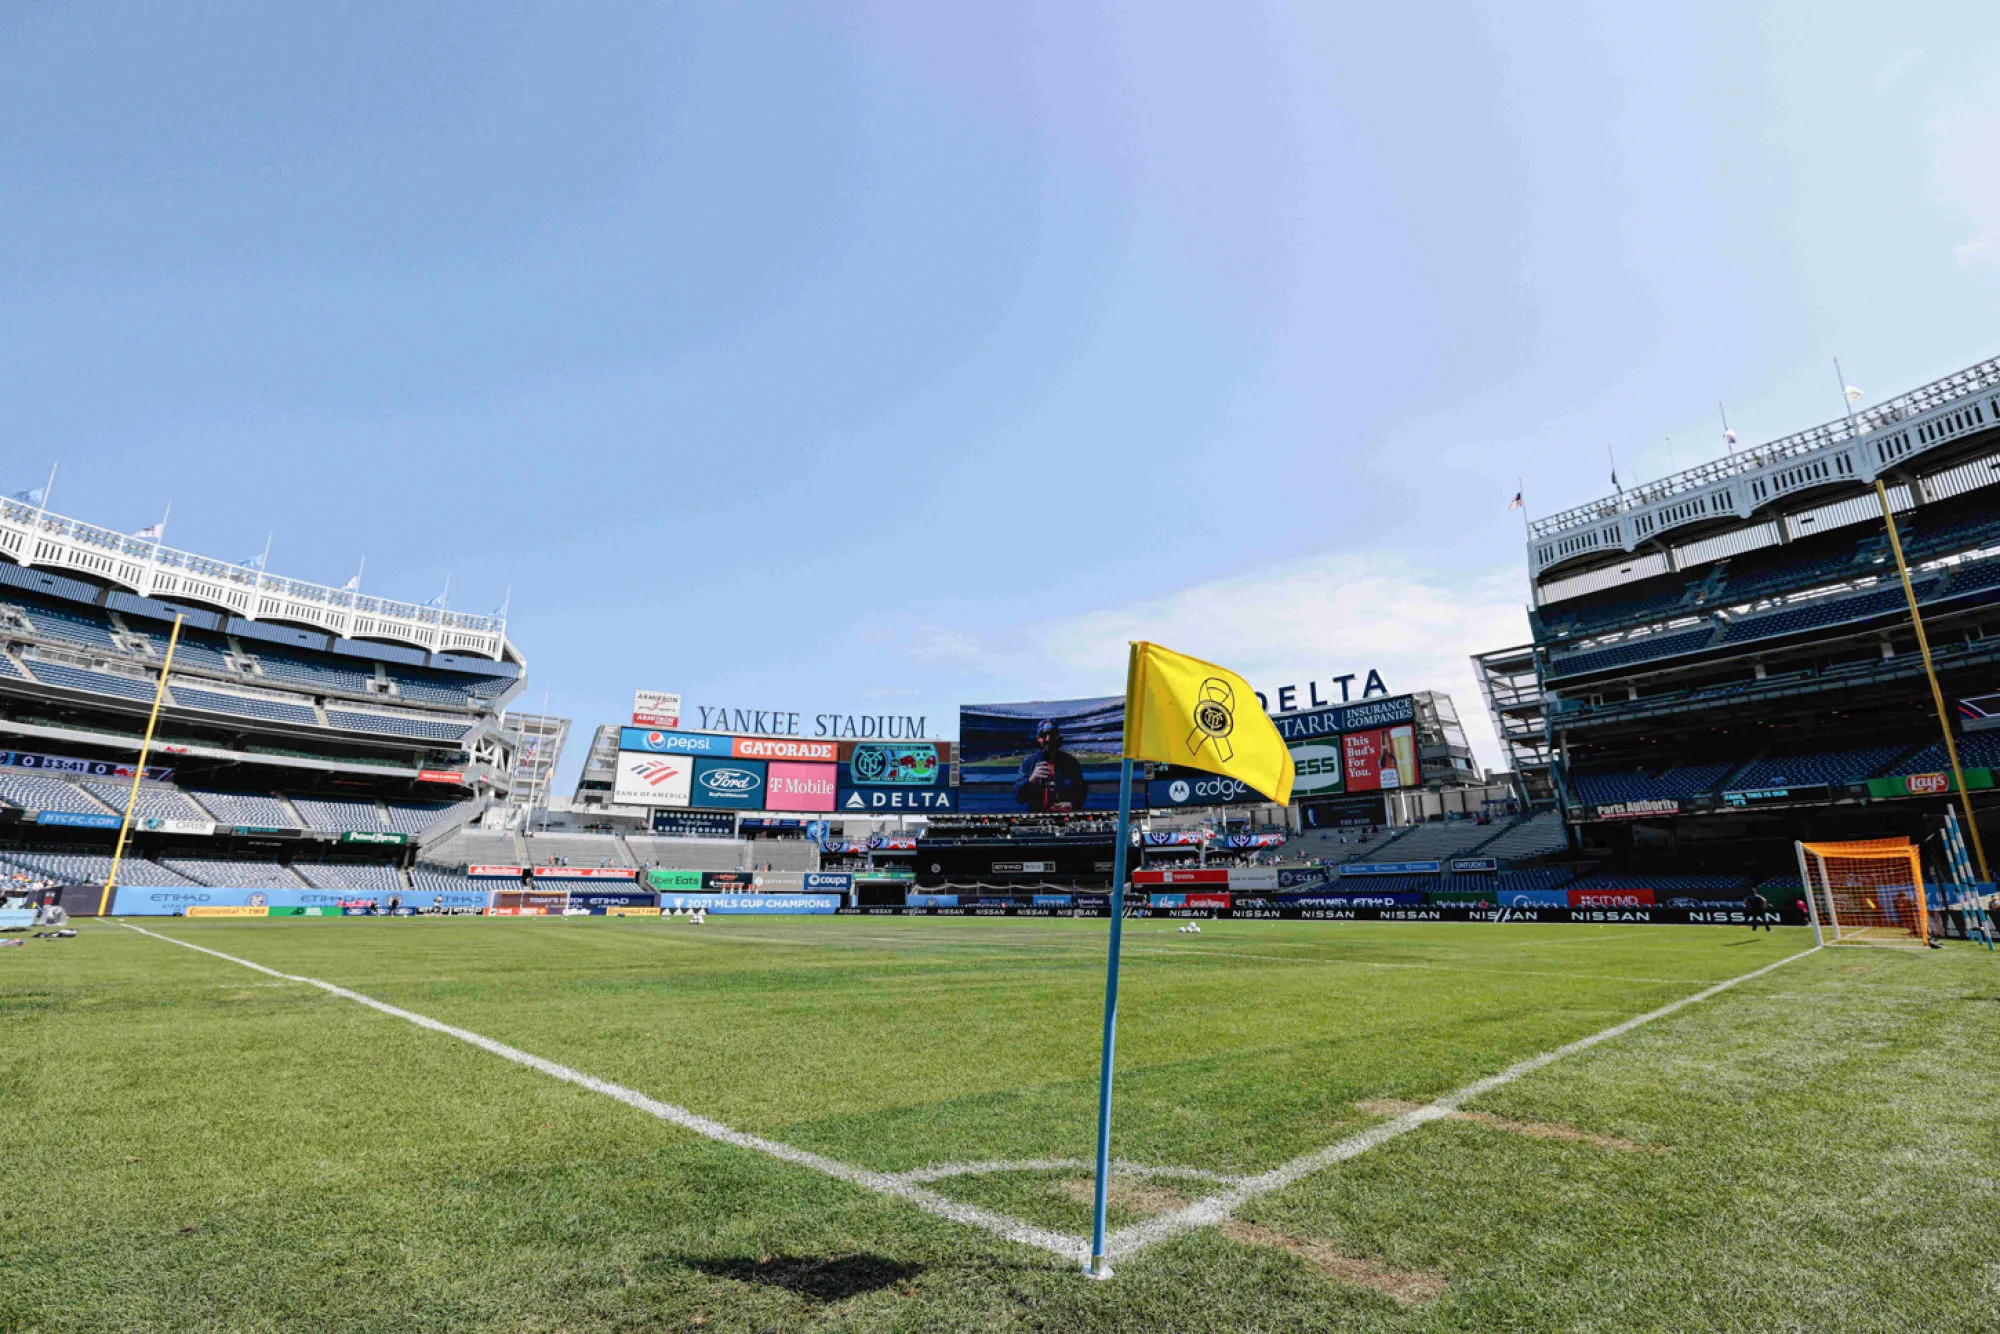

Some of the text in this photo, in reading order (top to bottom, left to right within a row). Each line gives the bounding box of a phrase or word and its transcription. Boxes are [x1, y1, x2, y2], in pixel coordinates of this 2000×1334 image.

[1346, 697, 1412, 719] INSURANCE
[697, 705, 927, 739] YANKEE STADIUM
[1347, 709, 1413, 728] COMPANIES
[1275, 713, 1340, 738] TARR
[667, 737, 711, 751] pepsi
[1344, 736, 1370, 747] This
[740, 741, 832, 758] GATORADE
[1347, 745, 1375, 756] Bud's
[22, 756, 107, 775] 0 33:41 0
[1295, 757, 1335, 776] ESS
[1348, 758, 1365, 768] For
[1348, 767, 1372, 777] You.
[710, 771, 749, 789] Ford
[1911, 774, 1946, 792] Lay's
[785, 779, 834, 794] Mobile
[1195, 777, 1247, 800] edge
[872, 792, 950, 807] DELTA
[1597, 803, 1626, 816] Parts
[1626, 799, 1680, 814] Authority
[45, 814, 116, 826] NYCFC.COM
[650, 875, 699, 885] Uber Eats
[820, 875, 847, 886] coupa
[151, 893, 211, 902] ETIHAD
[686, 900, 832, 909] 2021 MLS CUP CHAMPIONS
[189, 906, 240, 917] Continental
[975, 908, 1006, 916] NISSAN
[1017, 908, 1049, 916] NISSAN
[1301, 910, 1355, 918] NISSAN
[1380, 911, 1440, 919] NISSAN
[1571, 911, 1650, 921] NISSAN
